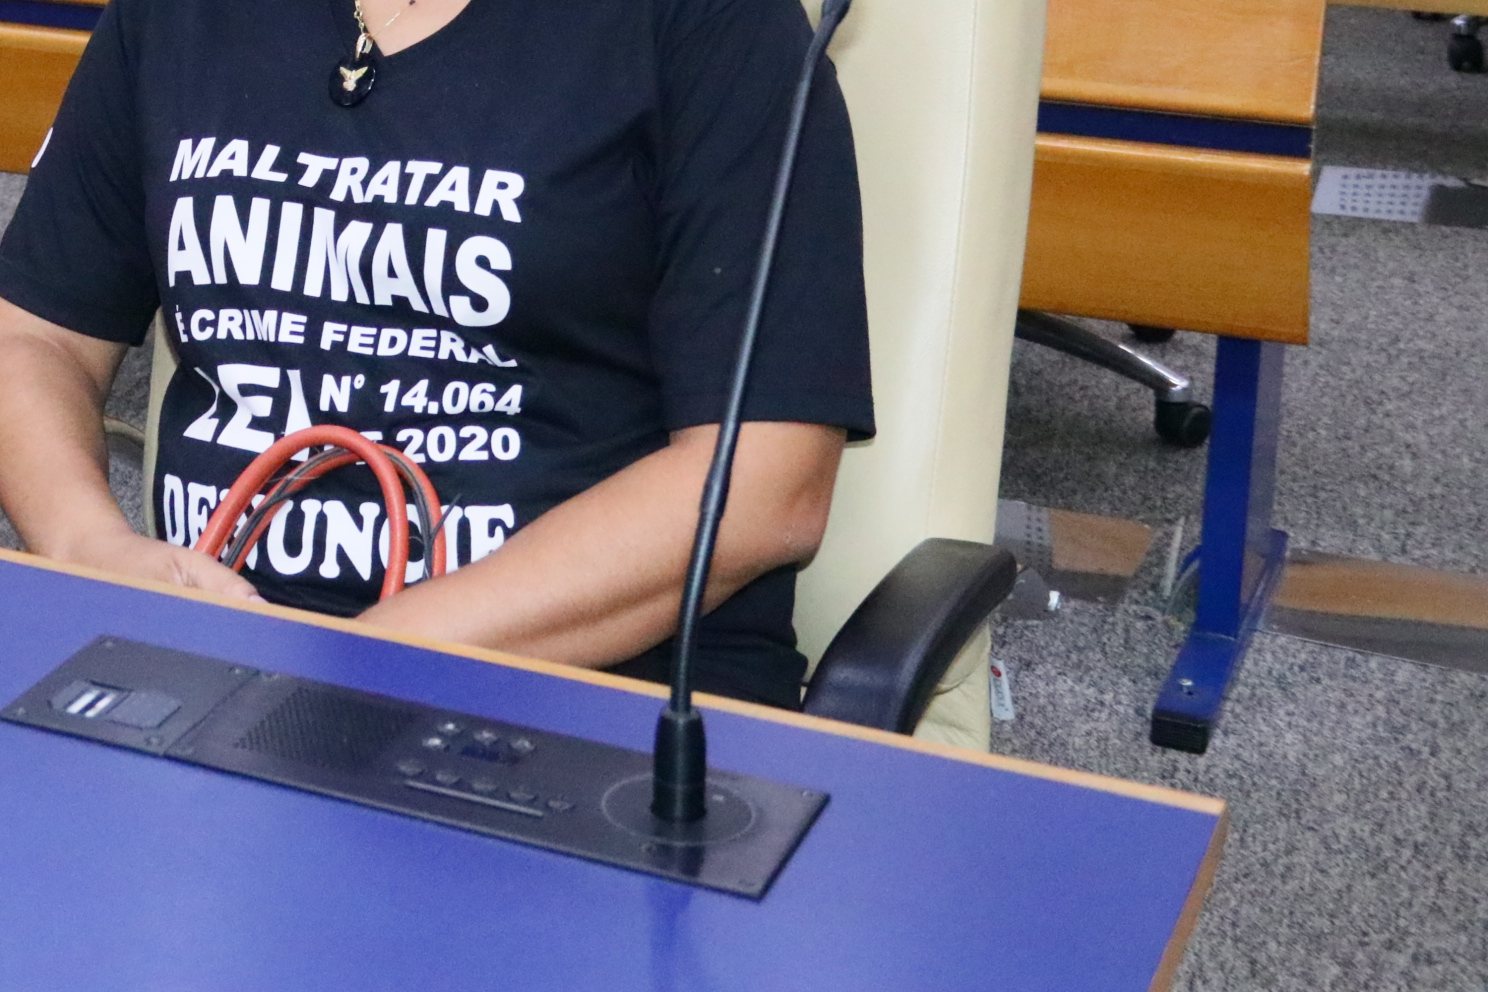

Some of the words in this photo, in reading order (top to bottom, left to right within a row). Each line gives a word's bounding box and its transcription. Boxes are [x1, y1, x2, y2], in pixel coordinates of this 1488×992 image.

[169, 136, 526, 224] MALTRATAR
[167, 194, 513, 328] ANIMAIS
[190, 308, 308, 345] CRIME
[379, 378, 524, 416] 14.064
[396, 425, 522, 464] 2020
